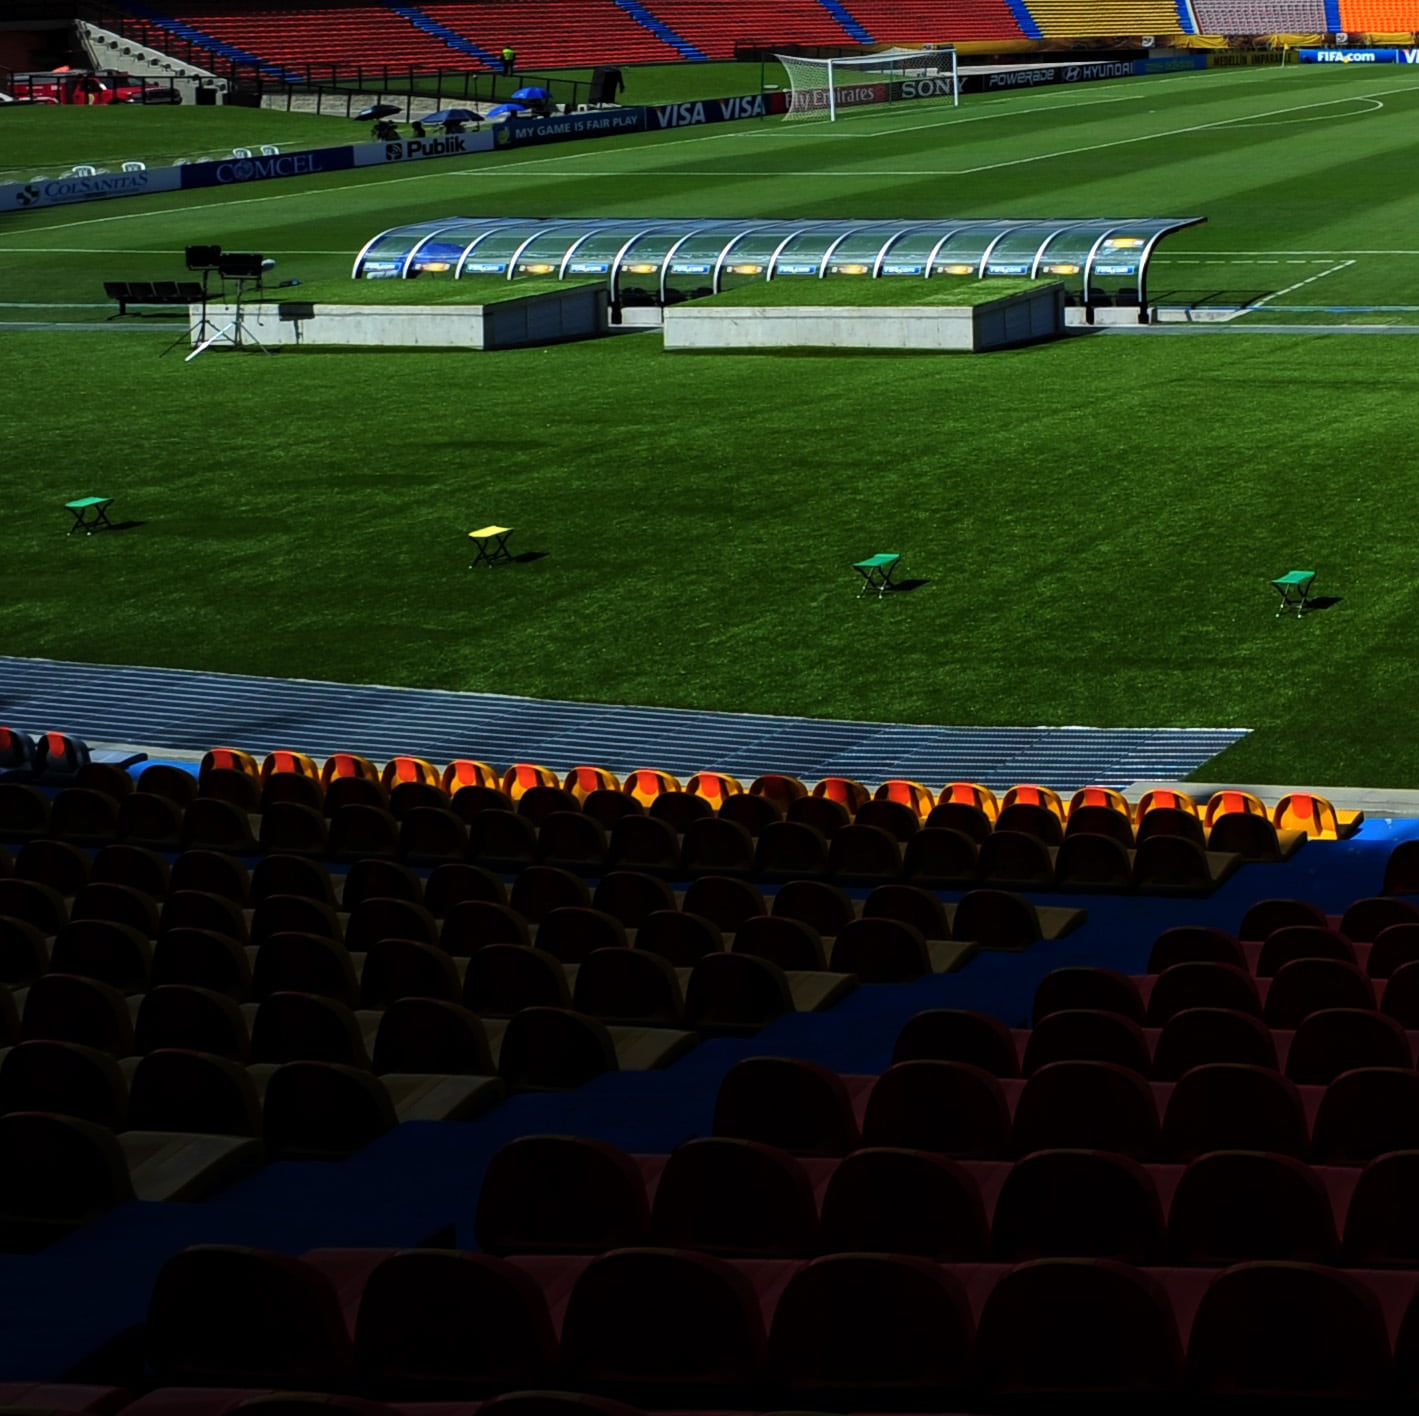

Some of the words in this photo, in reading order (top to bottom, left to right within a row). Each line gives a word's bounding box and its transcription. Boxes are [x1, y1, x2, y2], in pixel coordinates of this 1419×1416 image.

[1317, 51, 1375, 64] FIFA.com
[1083, 62, 1134, 81] HYUNDAI
[901, 77, 969, 99] SONY
[656, 102, 706, 128] VISA
[719, 95, 766, 120] VISA
[785, 92, 809, 111] Fly
[515, 127, 534, 139] MY
[537, 123, 571, 136] GAME
[574, 121, 583, 132] IS
[586, 118, 610, 131] FAIR
[612, 115, 638, 128] PLAY
[407, 136, 467, 159] Publik
